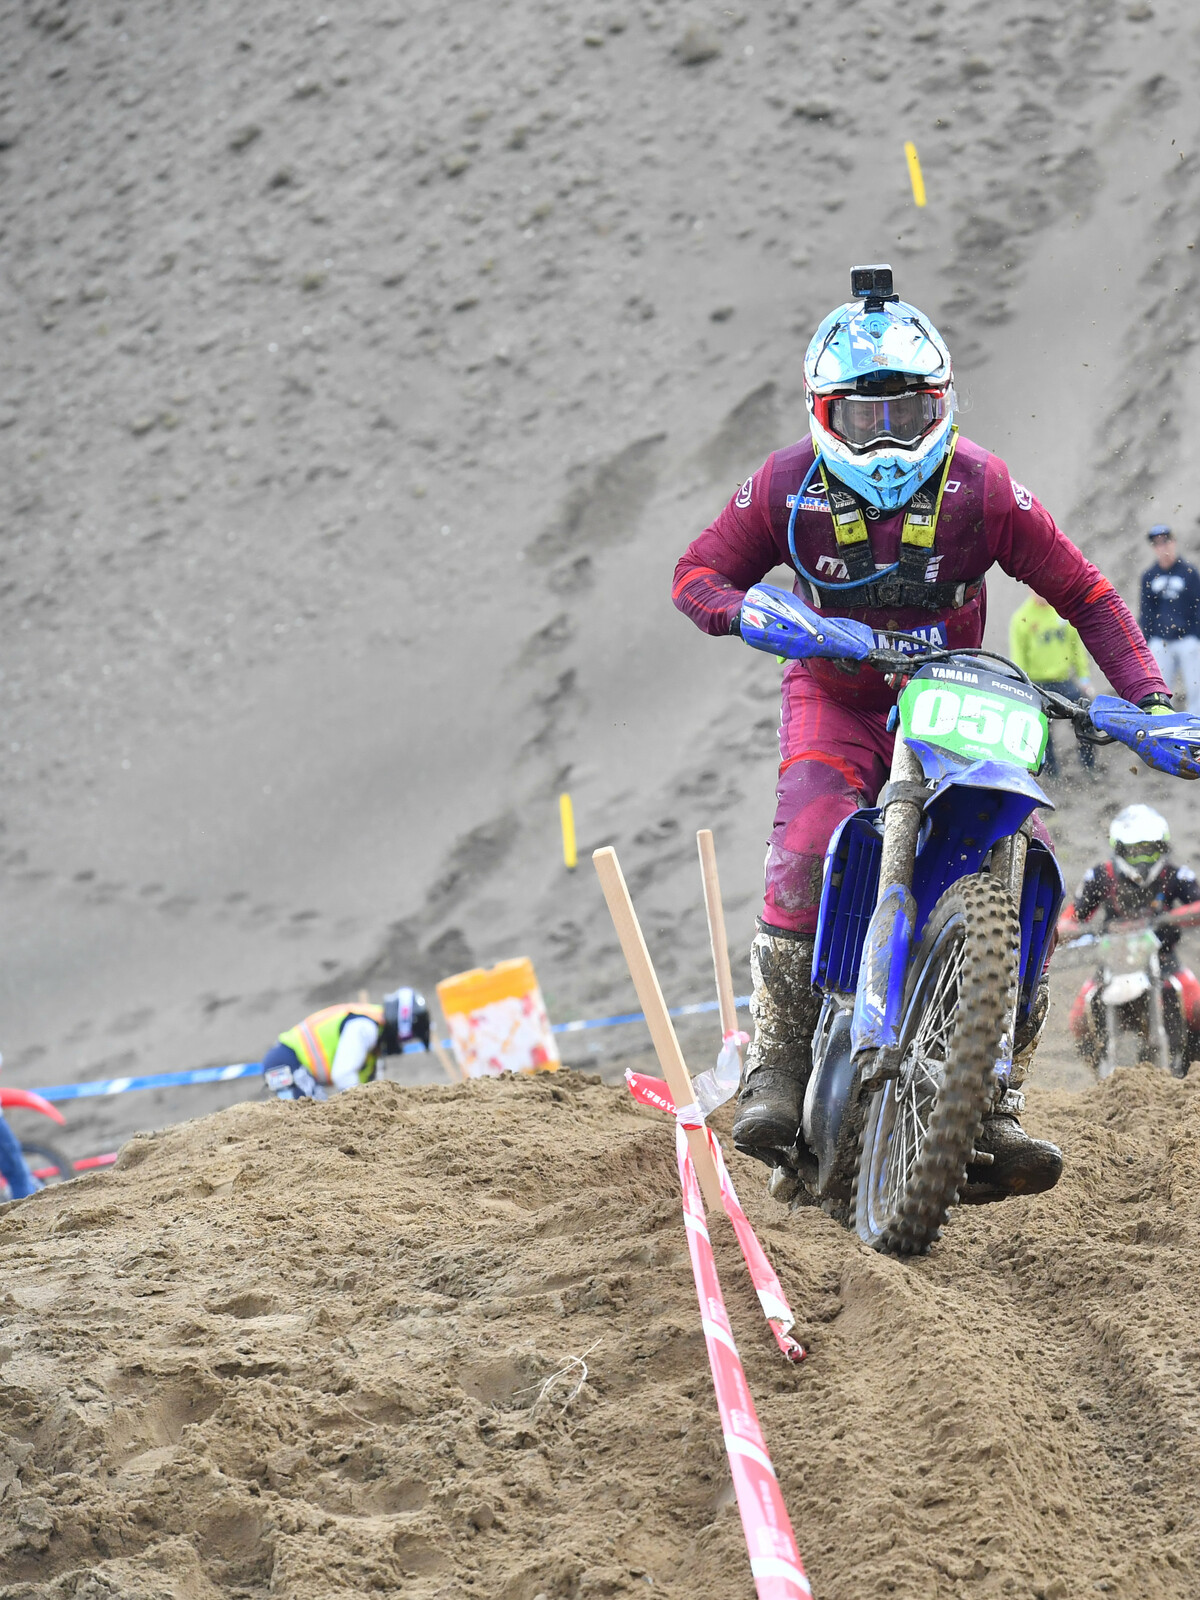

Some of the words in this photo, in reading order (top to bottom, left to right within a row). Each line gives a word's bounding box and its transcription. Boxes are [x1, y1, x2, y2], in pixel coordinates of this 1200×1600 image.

[787, 503, 831, 511] ULIMITE
[872, 626, 943, 652] MAHA
[931, 667, 979, 684] YAMAHA
[991, 680, 1033, 701] RANDY
[910, 689, 1044, 769] 050
